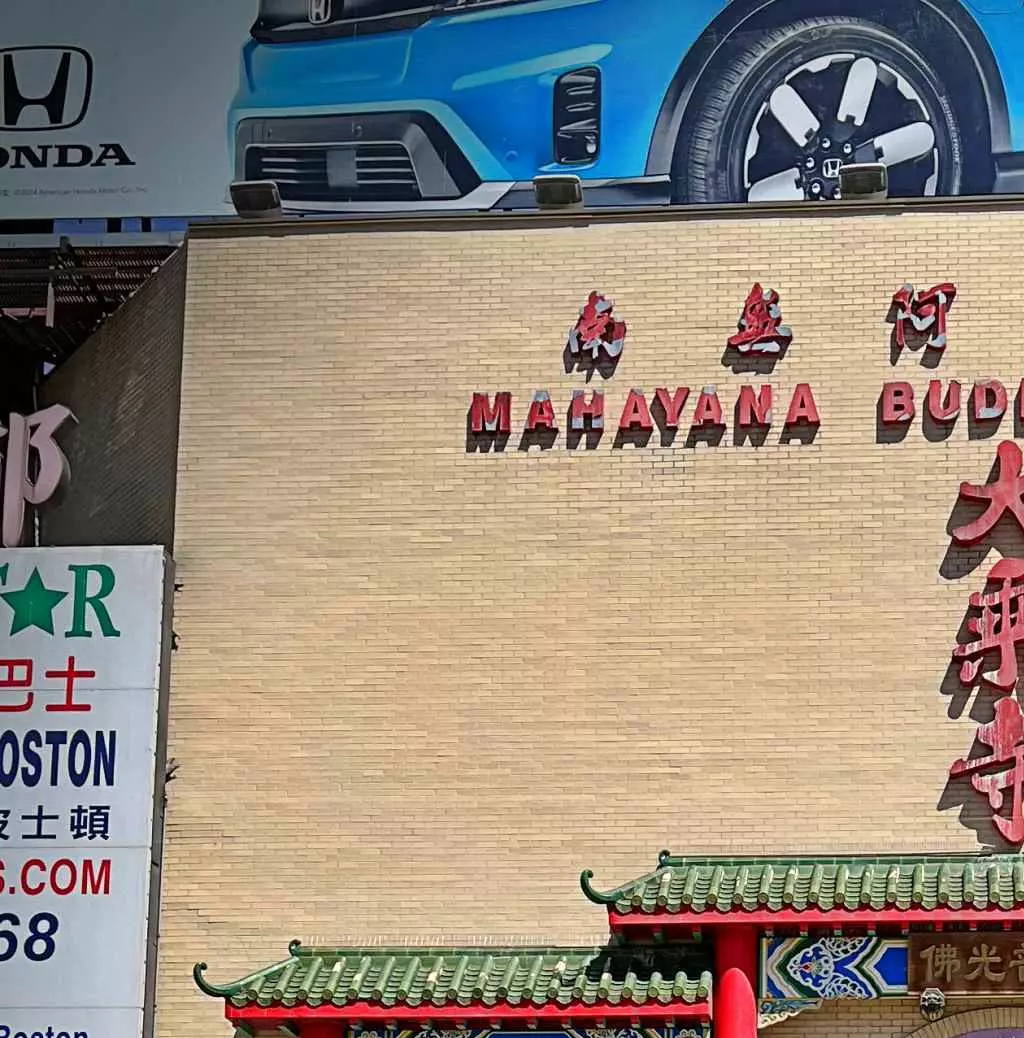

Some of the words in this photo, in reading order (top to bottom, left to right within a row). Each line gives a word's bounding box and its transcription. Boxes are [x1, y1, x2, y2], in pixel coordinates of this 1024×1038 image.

[0, 143, 136, 169] NDA
[471, 383, 820, 432] MAHAYANA
[0, 858, 111, 895] .COM
